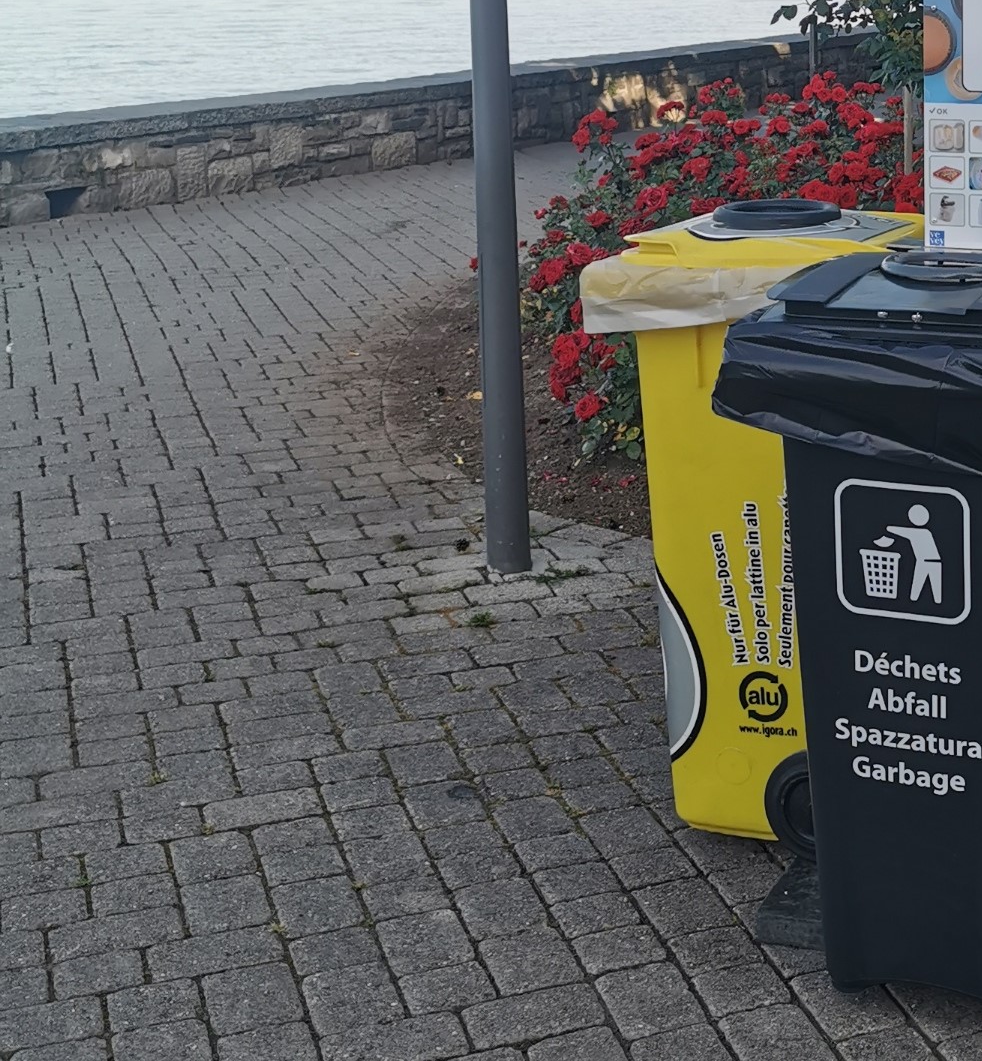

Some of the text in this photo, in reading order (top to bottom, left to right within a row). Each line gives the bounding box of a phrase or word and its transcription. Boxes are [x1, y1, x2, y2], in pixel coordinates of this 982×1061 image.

[712, 533, 748, 663] Nur für Alu-Dosen
[743, 503, 770, 663] Solo per lattine in alu
[778, 586, 793, 667] Seulement
[854, 649, 962, 685] Déchets
[748, 686, 779, 706] alu
[867, 687, 947, 719] Abfall
[739, 724, 798, 738] www.igora.ch
[834, 717, 982, 759] Spazzatura
[852, 755, 966, 796] Garbage
